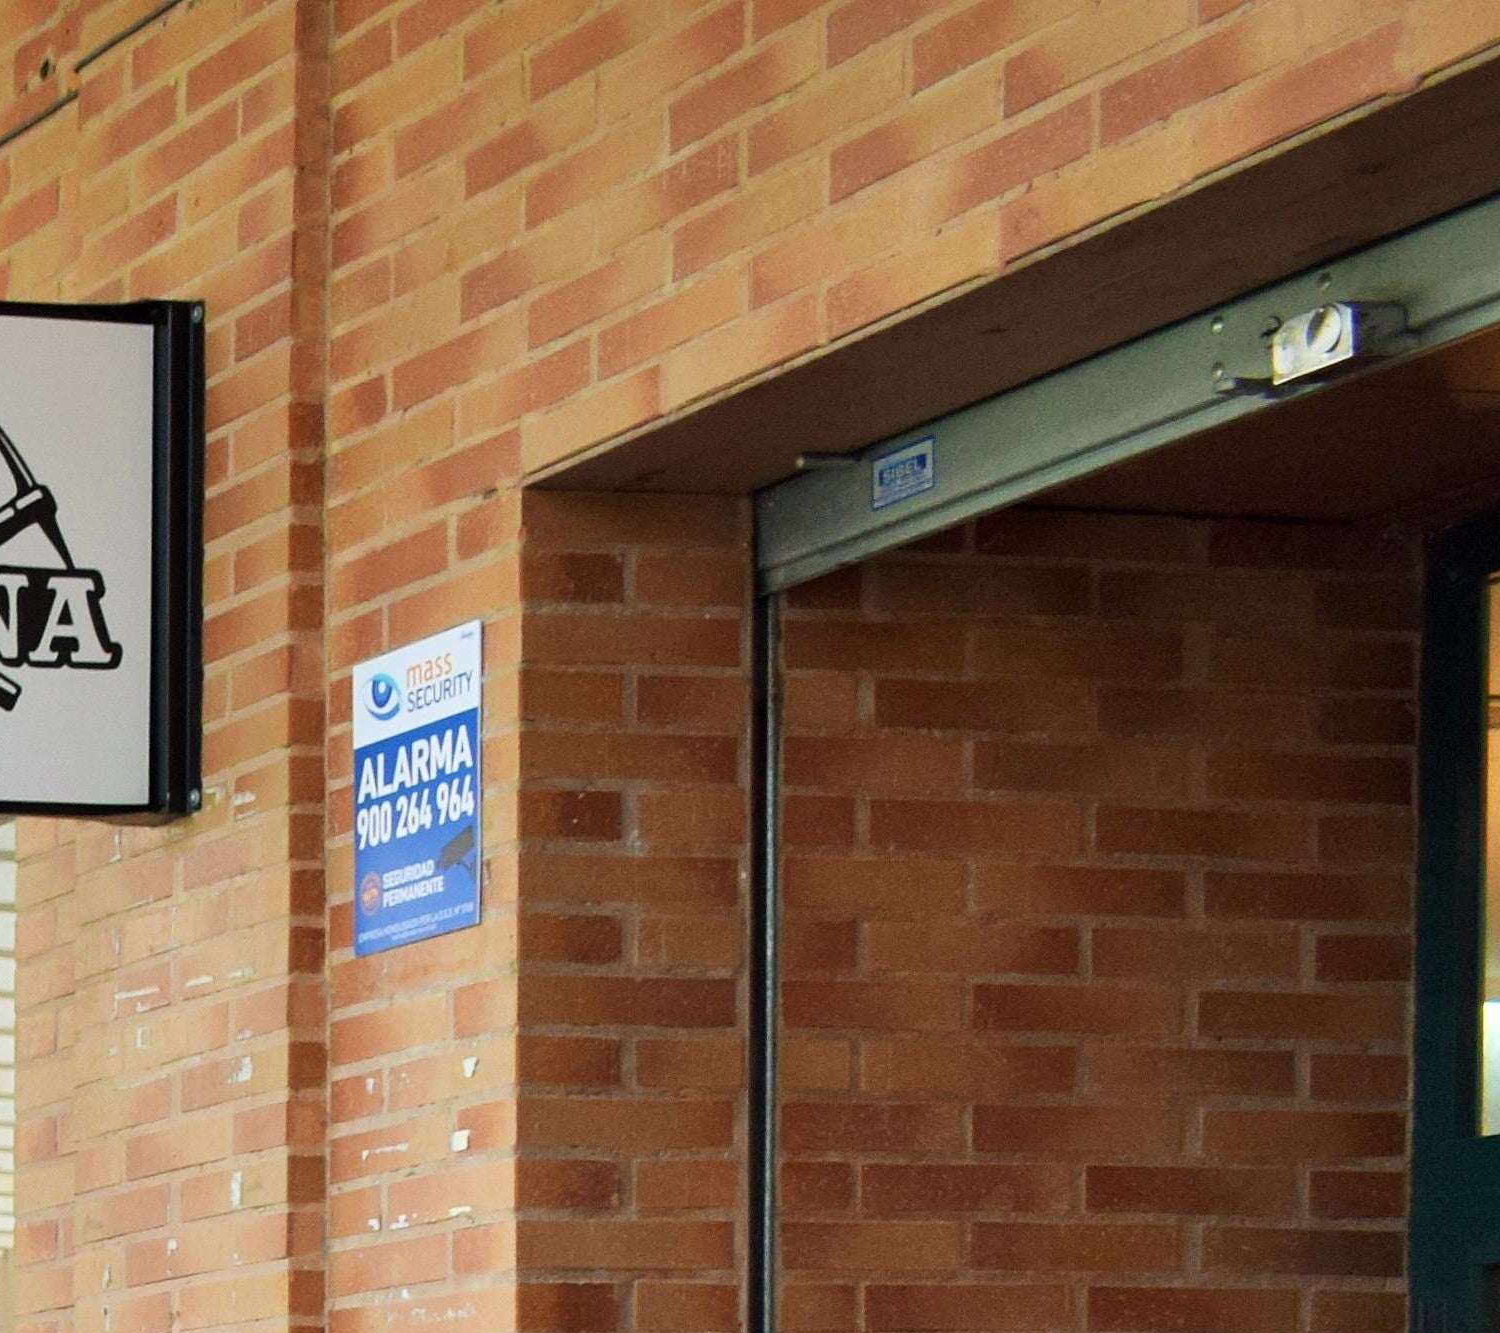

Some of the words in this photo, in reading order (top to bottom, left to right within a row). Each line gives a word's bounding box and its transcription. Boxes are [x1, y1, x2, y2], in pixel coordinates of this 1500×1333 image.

[405, 653, 453, 687] mass
[406, 669, 474, 713] SECURITY
[357, 724, 474, 805] ALARMA
[356, 800, 392, 850] 900
[396, 788, 432, 839] 264
[436, 774, 475, 825] 964
[382, 859, 435, 890] SEGURIDAD
[382, 875, 445, 908] PERMANENTE
